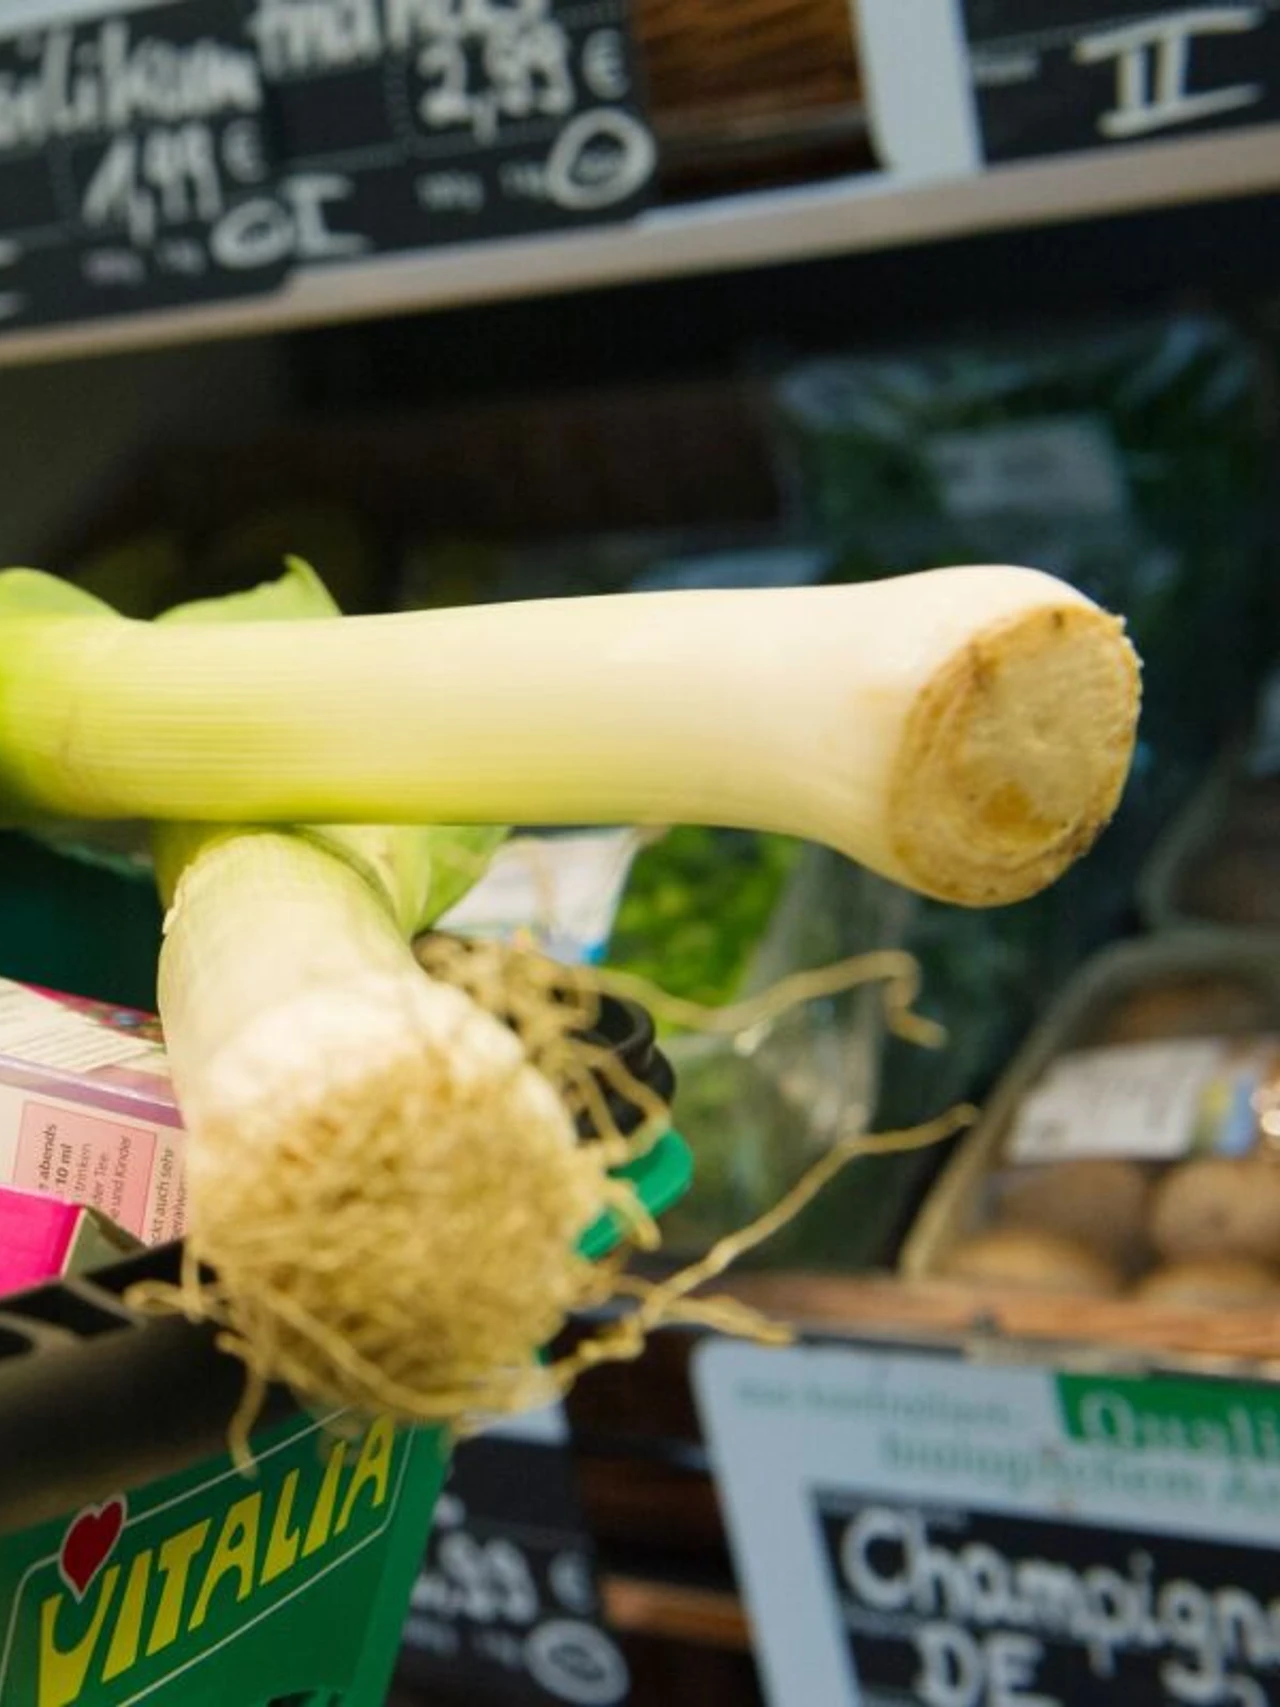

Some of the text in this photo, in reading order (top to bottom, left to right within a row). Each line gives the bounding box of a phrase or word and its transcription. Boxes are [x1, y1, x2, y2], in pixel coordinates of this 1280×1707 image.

[35, 1124, 58, 1181] abends
[55, 1143, 72, 1186] 10 ml
[114, 1135, 132, 1178] Kinder
[38, 1412, 395, 1707] VITALIA
